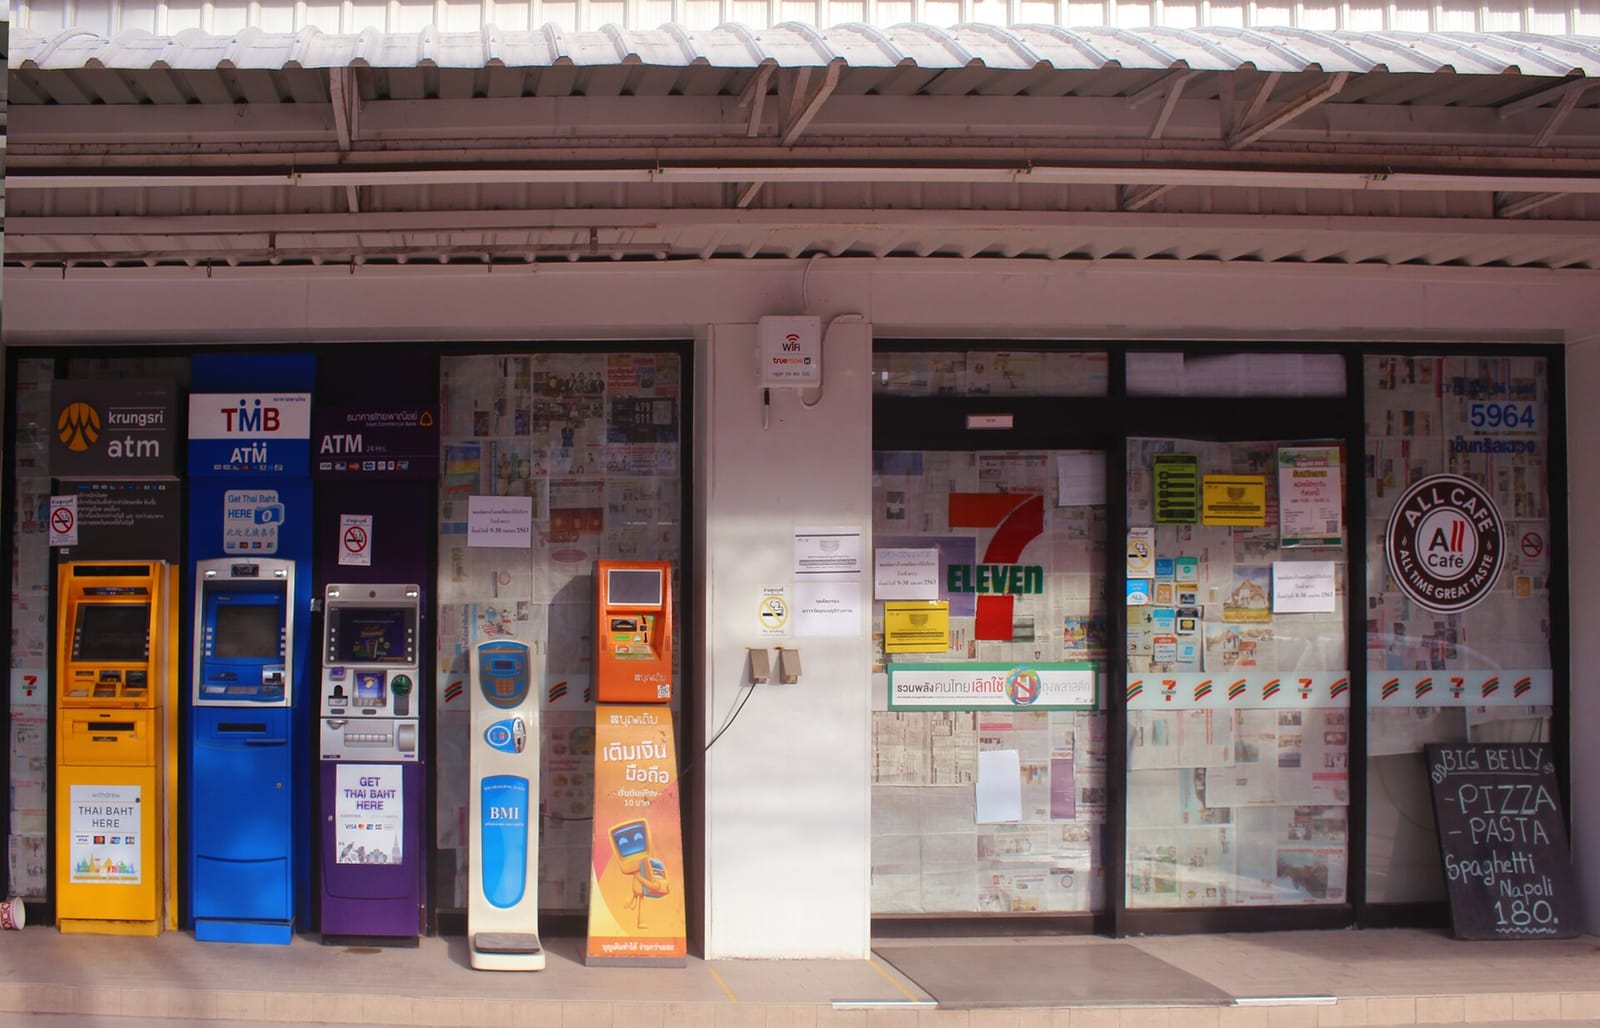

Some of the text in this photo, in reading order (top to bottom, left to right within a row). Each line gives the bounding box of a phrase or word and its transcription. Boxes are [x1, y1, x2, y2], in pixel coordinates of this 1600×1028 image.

[108, 411, 164, 426] krungsri
[221, 399, 280, 432] TMB
[1471, 404, 1535, 427] 5964
[108, 436, 160, 457] atm
[230, 442, 268, 463] ATM
[320, 433, 363, 453] ATM
[228, 509, 253, 518] HERE
[1405, 488, 1444, 528] ALL
[1428, 520, 1465, 552] All
[948, 492, 1044, 641] 7
[1400, 549, 1494, 600] ALL TIME GREAT TASTE
[603, 741, 667, 761] เติมเงิน
[1442, 748, 1543, 771] BIG BELLY
[359, 777, 380, 787] GET
[626, 763, 669, 784] มือถือ
[344, 790, 396, 799] THAI BAHT
[1458, 784, 1557, 815] PIZZA
[79, 806, 134, 816] THAI BAHT
[356, 801, 384, 810] HERE
[489, 807, 519, 820] BMI
[92, 819, 120, 828] HERE
[1469, 816, 1550, 845] PASTA
[1446, 850, 1535, 886] Spaghetti
[1500, 875, 1553, 905] Napoli
